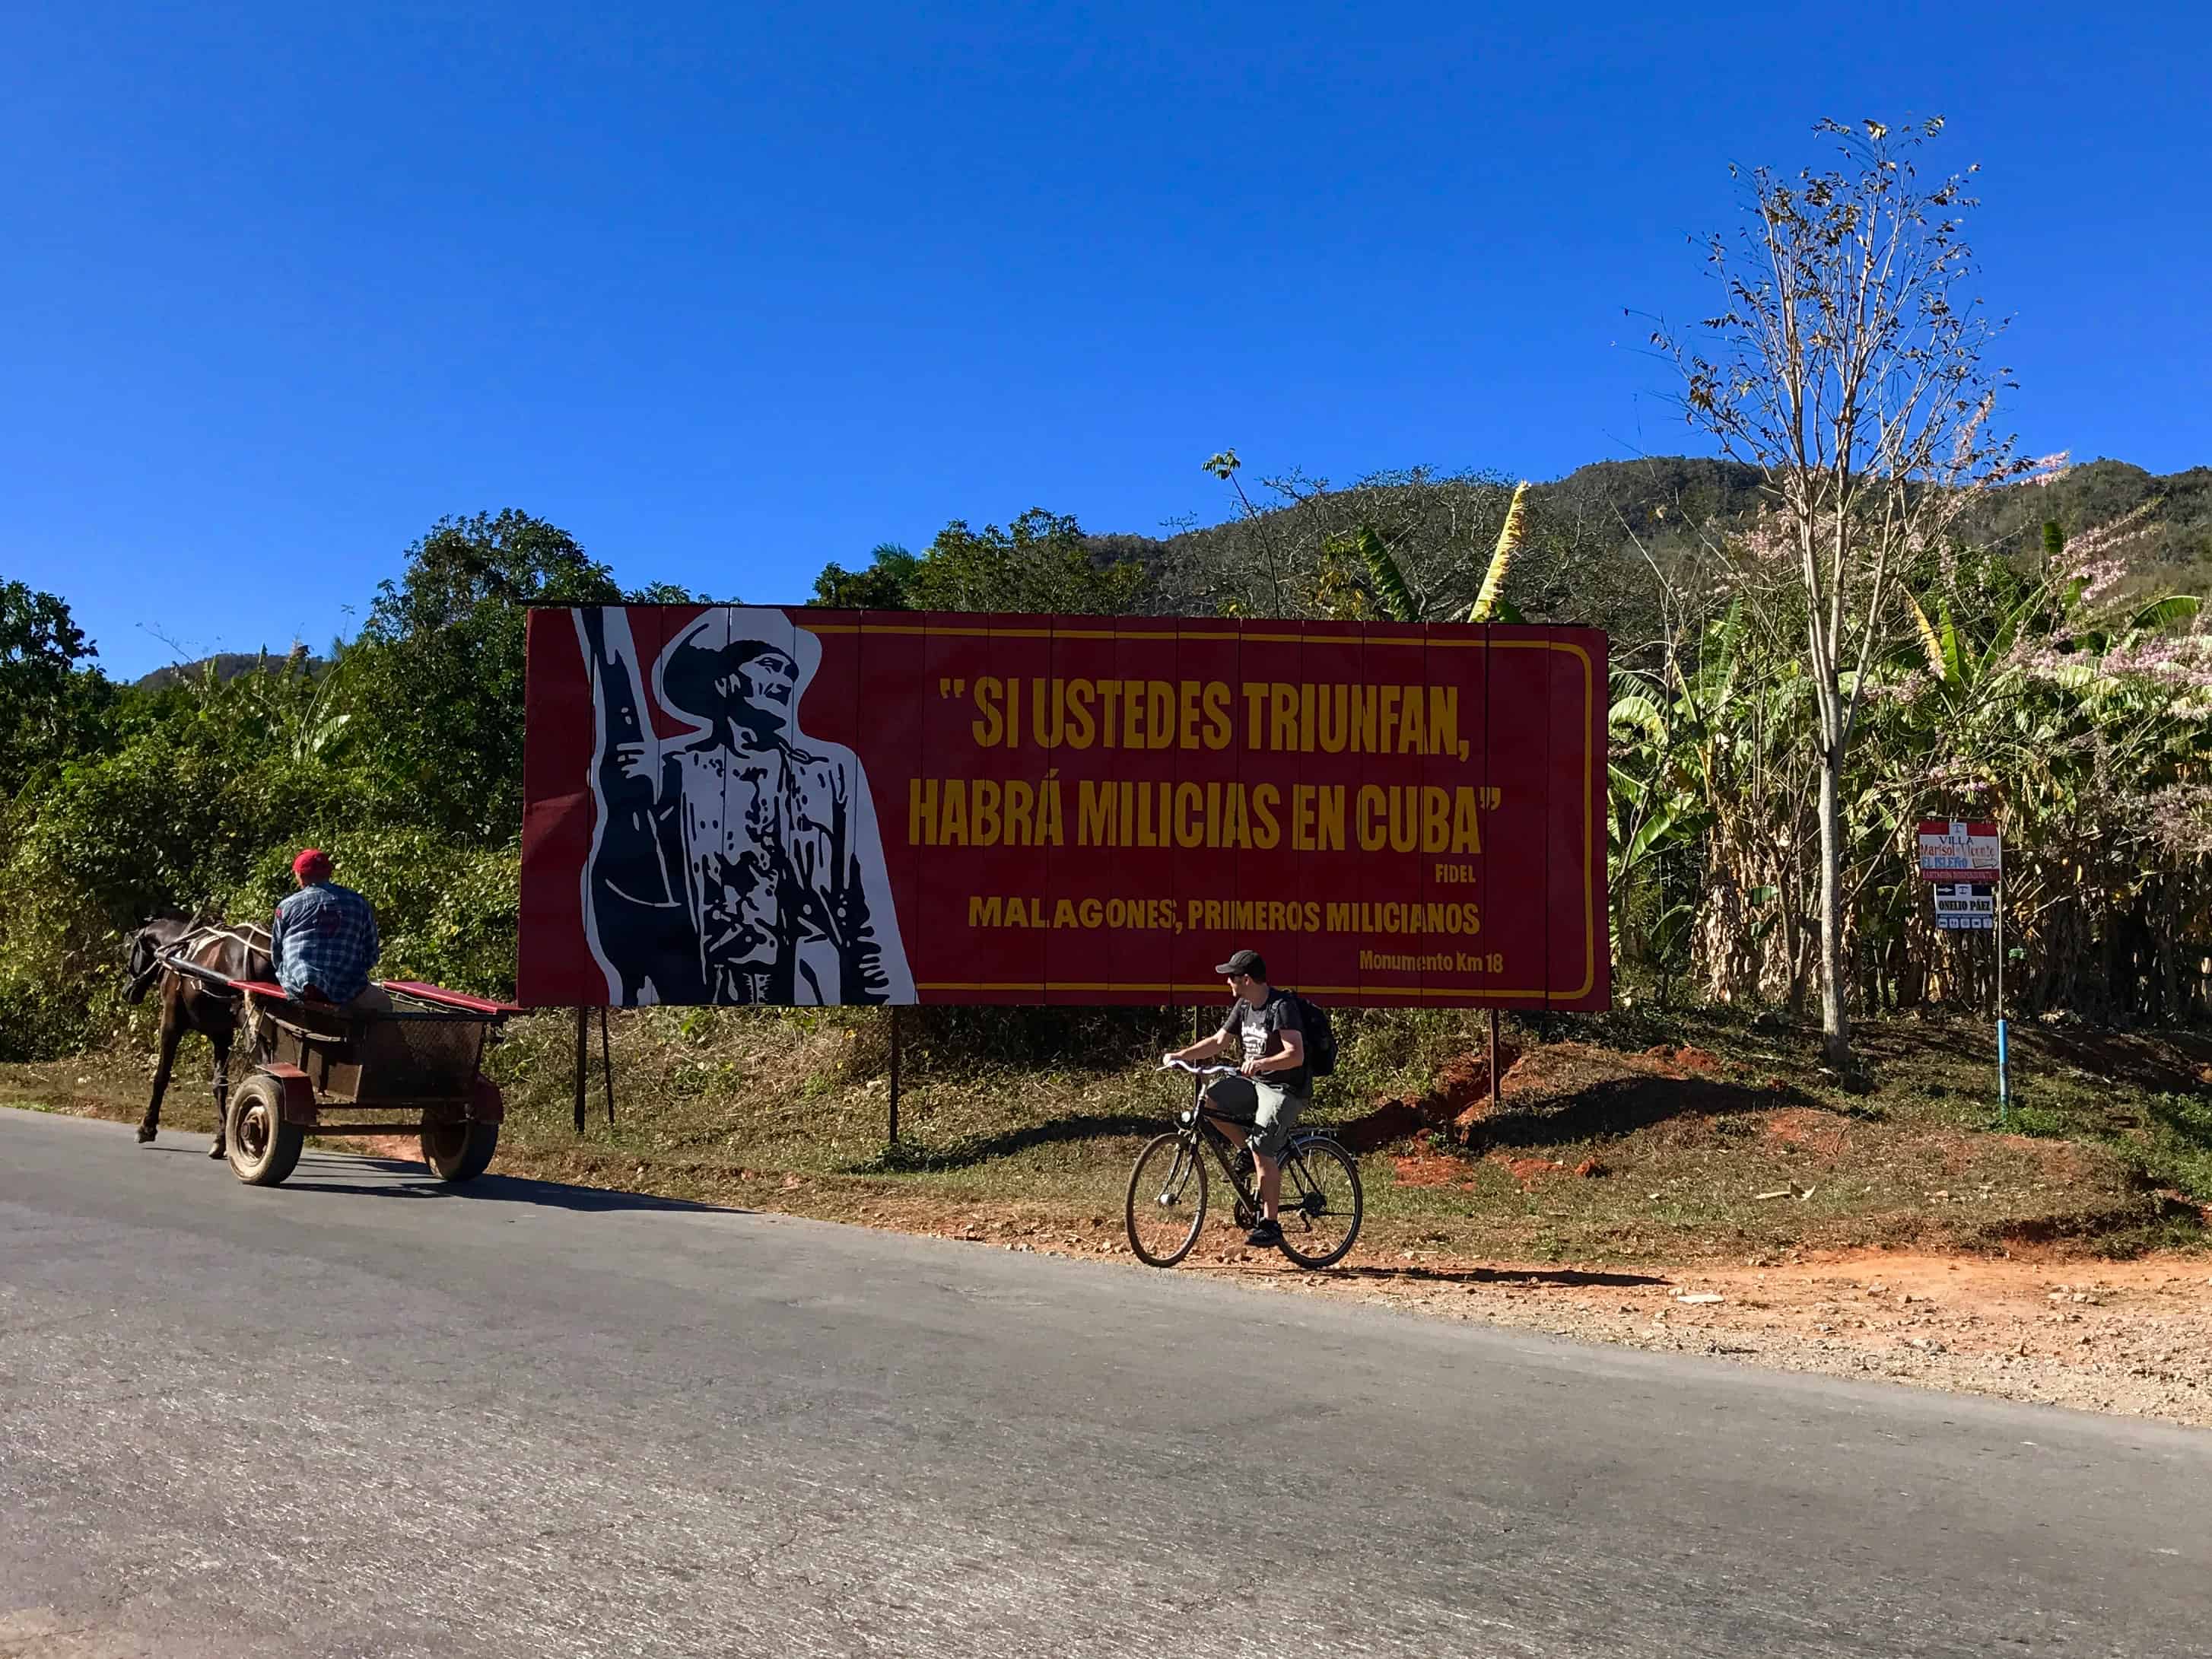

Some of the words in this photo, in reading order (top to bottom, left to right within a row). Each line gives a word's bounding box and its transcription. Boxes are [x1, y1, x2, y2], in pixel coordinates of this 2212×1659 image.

[1033, 679, 1232, 750] USTEDES
[1243, 682, 1470, 761] TRIUNFAN,
[909, 769, 1064, 847] HABRÁ
[1077, 780, 1280, 850] MILICIAS
[1292, 784, 1346, 851] EN
[1921, 844, 1955, 857] Marisol
[1938, 836, 1974, 845] VILLA
[1435, 864, 1476, 883] FIDEL
[1187, 900, 1321, 933] PRIMEROS
[1326, 901, 1480, 935] MILICIANOS
[1359, 949, 1454, 972] Monumento
[1457, 951, 1483, 973] Km
[1486, 952, 1504, 974] 18
